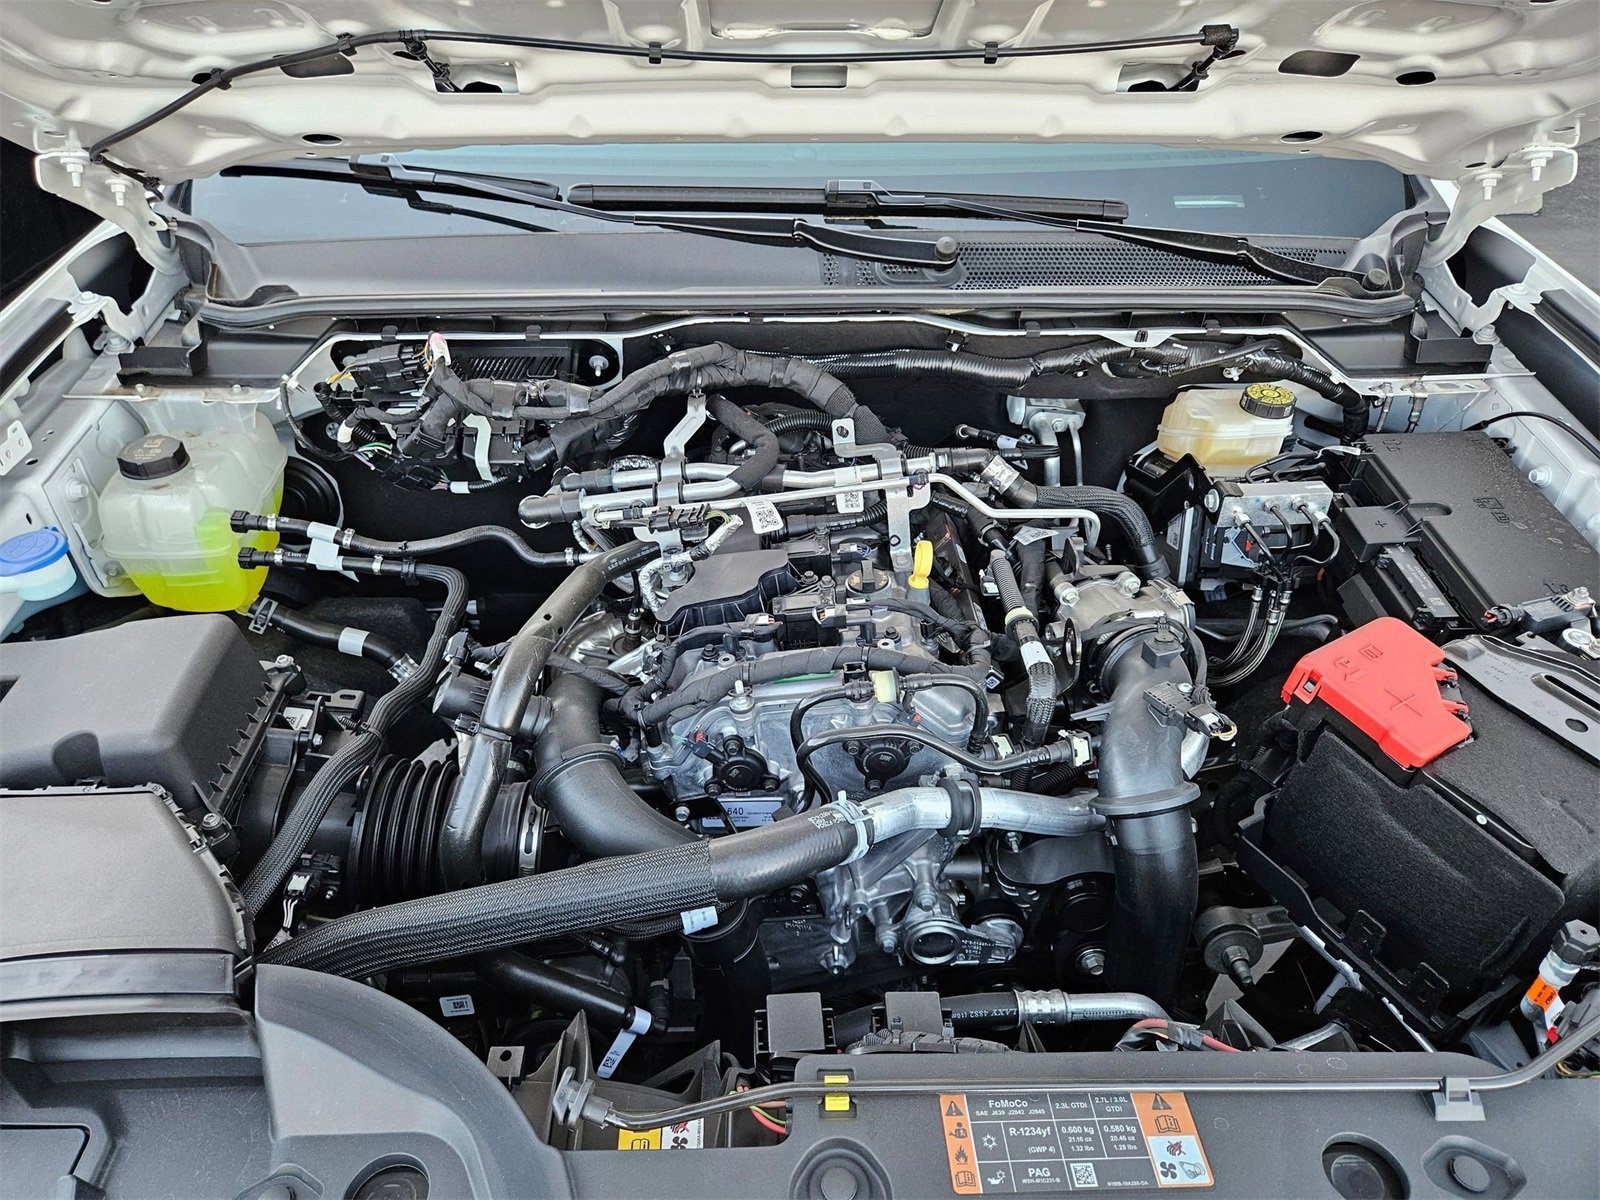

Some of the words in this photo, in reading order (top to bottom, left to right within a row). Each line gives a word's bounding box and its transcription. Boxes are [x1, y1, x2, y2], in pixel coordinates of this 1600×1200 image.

[969, 1010, 989, 1018] 4882
[988, 1099, 1028, 1108] FoMoCo
[1009, 1126, 1052, 1137] R-1234yf
[1084, 1125, 1094, 1134] kg
[1126, 1124, 1137, 1134] kg
[1028, 1146, 1048, 1154] (GWP
[1048, 1146, 1056, 1154] 4)
[1028, 1167, 1051, 1177] PAG
